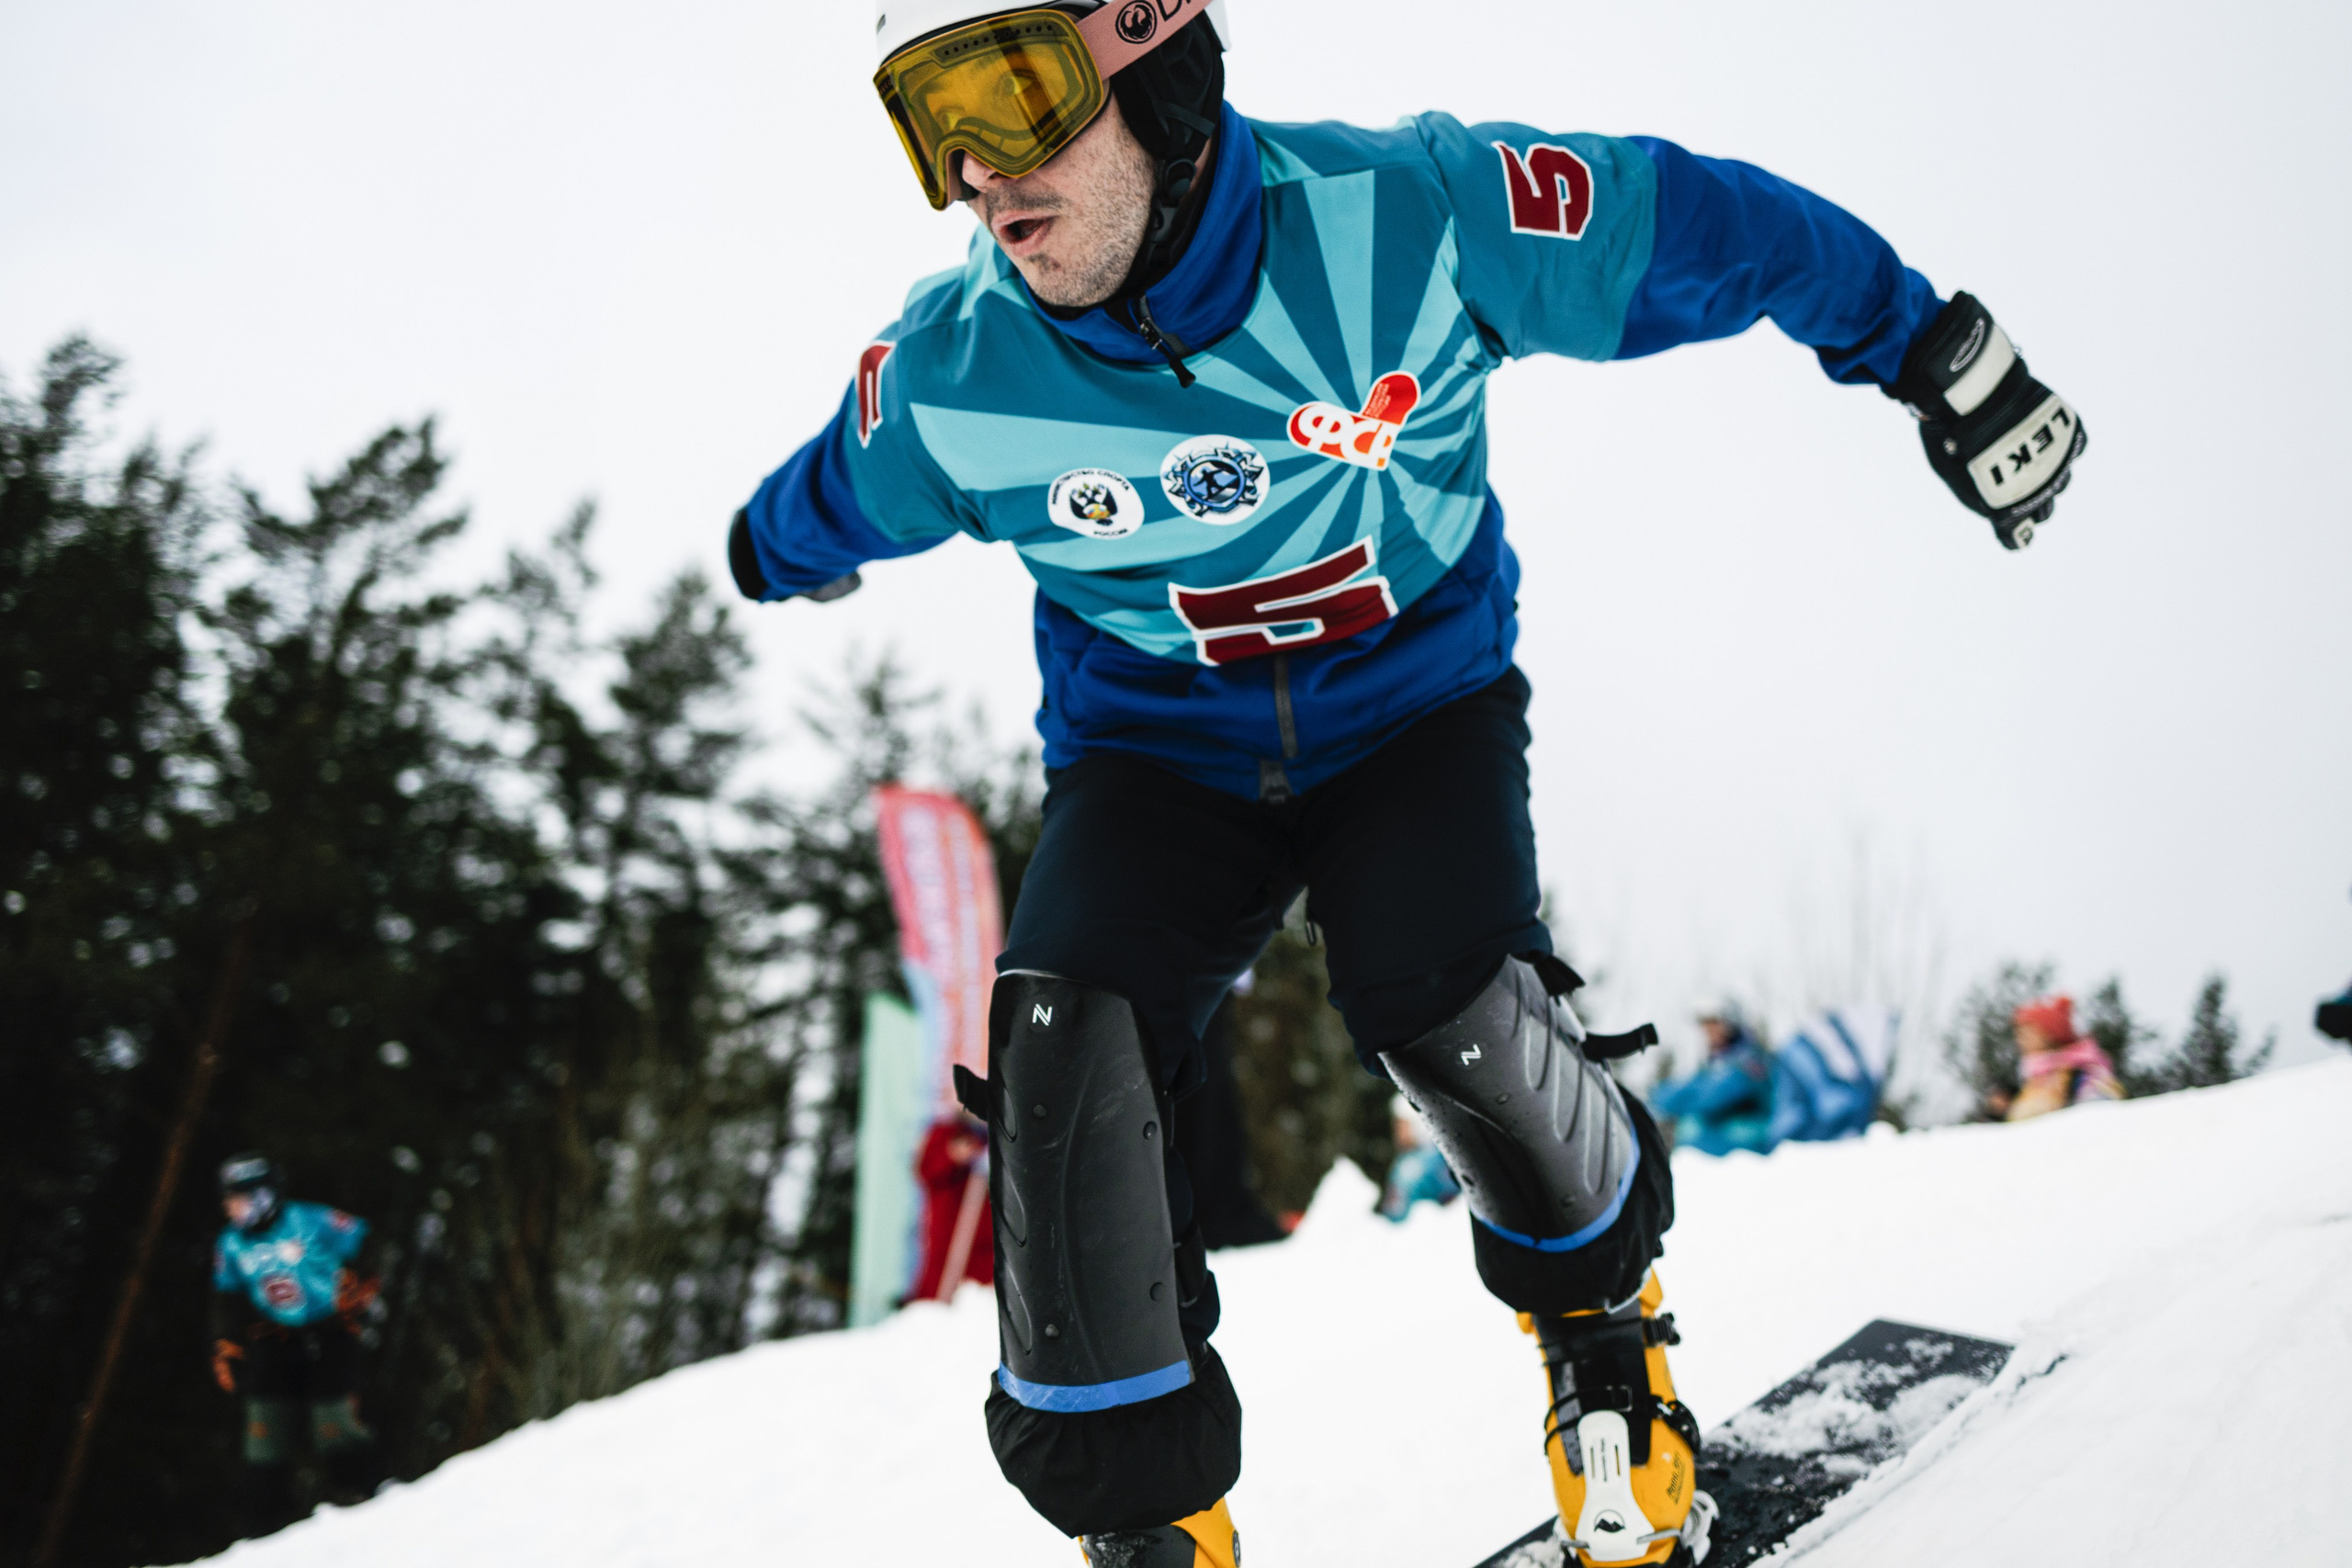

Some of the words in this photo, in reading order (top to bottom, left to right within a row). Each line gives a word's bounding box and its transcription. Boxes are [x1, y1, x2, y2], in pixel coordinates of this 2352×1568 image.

[1490, 141, 1594, 242] 5
[1990, 407, 2070, 485] LEKI
[1168, 536, 1398, 667] 5
